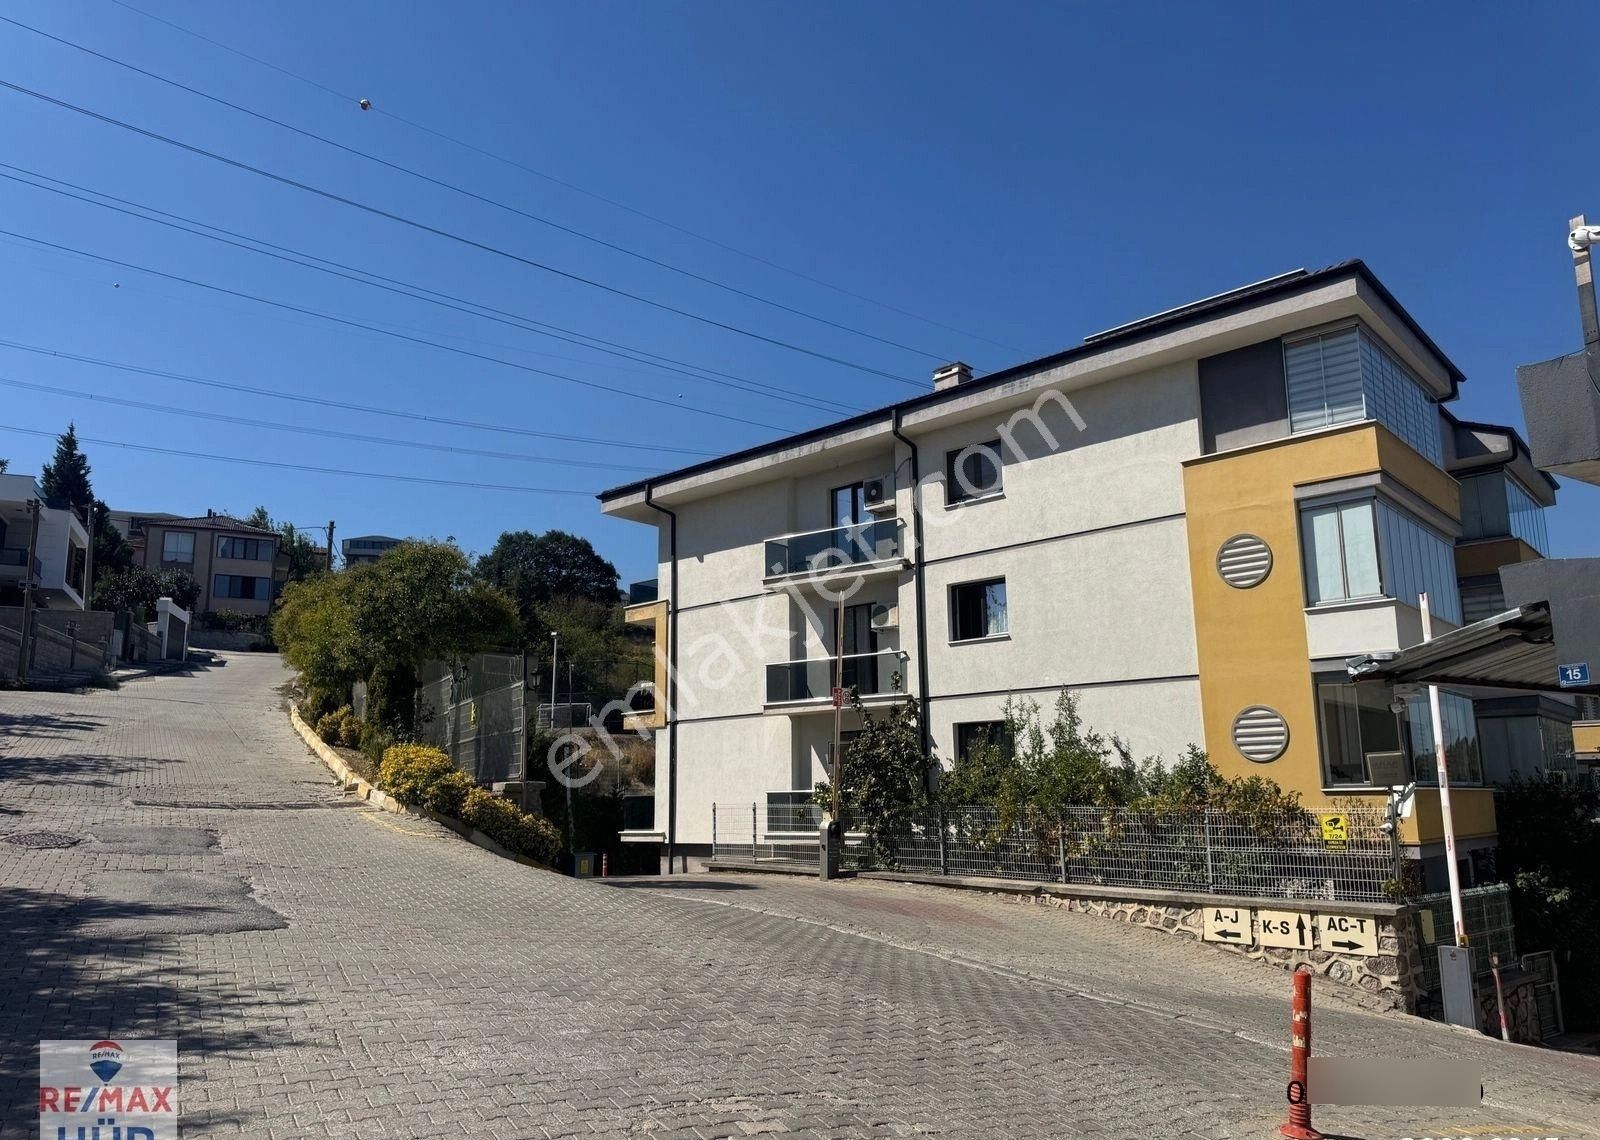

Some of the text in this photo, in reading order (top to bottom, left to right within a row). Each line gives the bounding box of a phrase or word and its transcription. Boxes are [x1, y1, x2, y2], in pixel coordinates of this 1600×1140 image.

[1566, 669, 1581, 680] 15
[1214, 909, 1239, 924] A-J
[1262, 920, 1290, 935] K-S
[1327, 917, 1367, 934] AC-T
